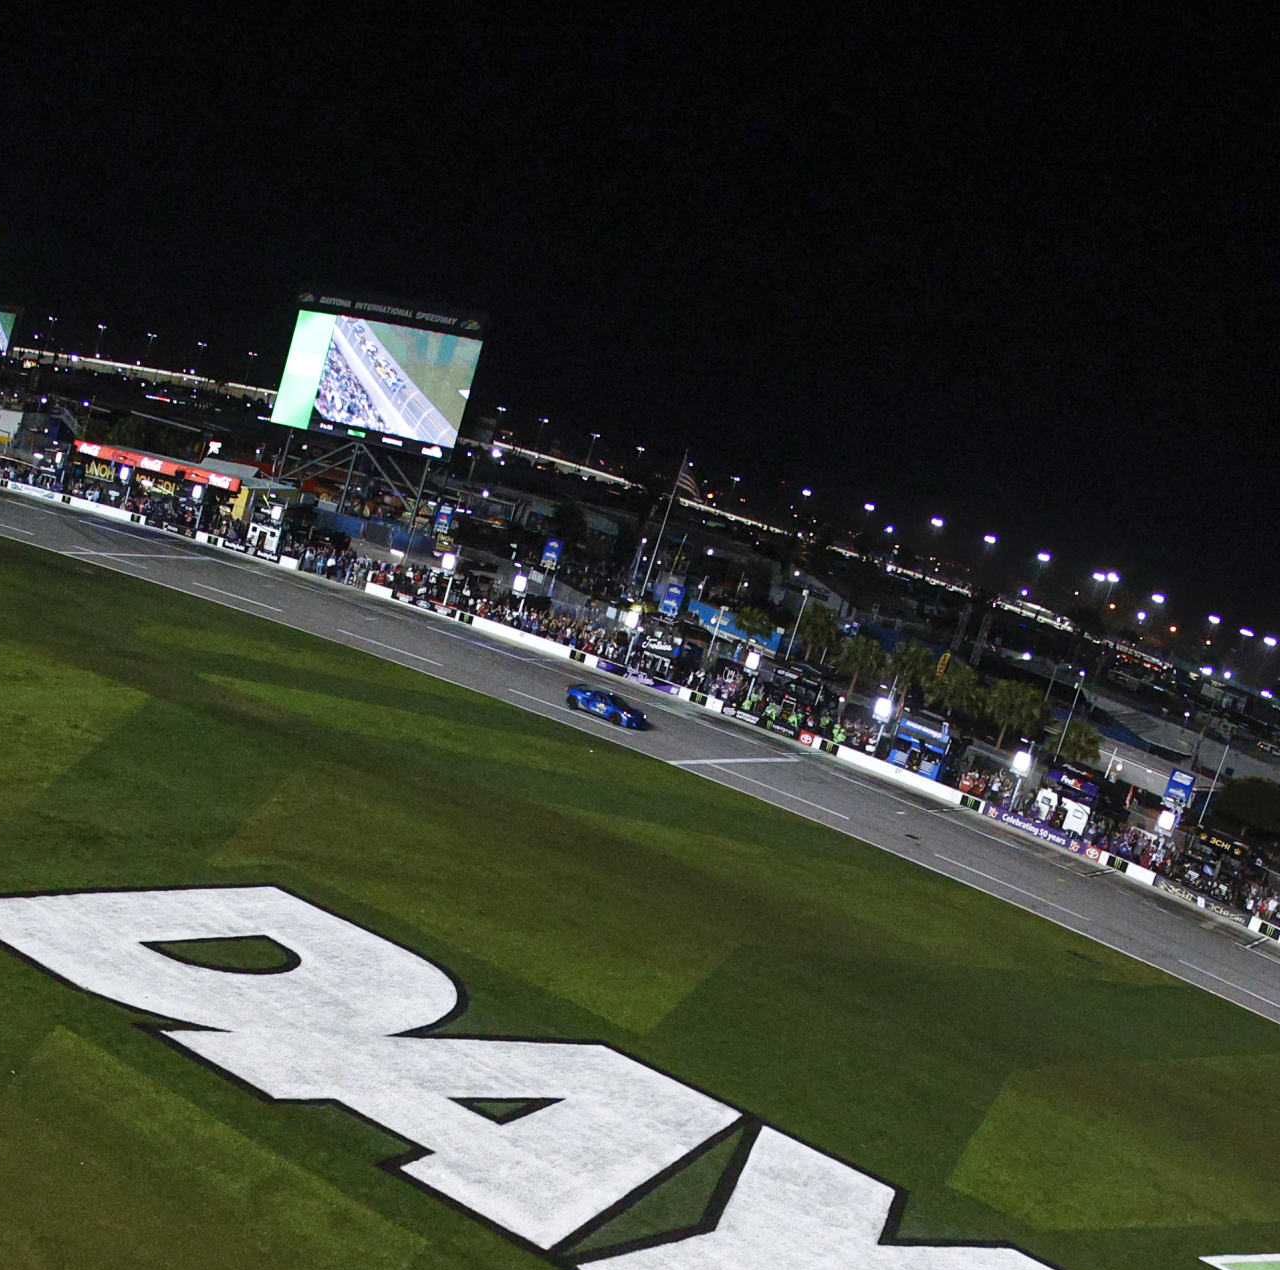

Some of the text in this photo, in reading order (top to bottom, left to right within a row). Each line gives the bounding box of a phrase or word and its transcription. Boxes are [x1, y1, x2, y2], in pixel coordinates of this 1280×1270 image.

[320, 297, 457, 325] DAYTONA INTERNATIONAL SPEEDWAY
[1060, 774, 1082, 788] FedEx
[1002, 813, 1039, 836] Celebrating
[1038, 827, 1048, 839] 50
[1047, 832, 1066, 847] years
[1209, 836, 1232, 851] 3CHI
